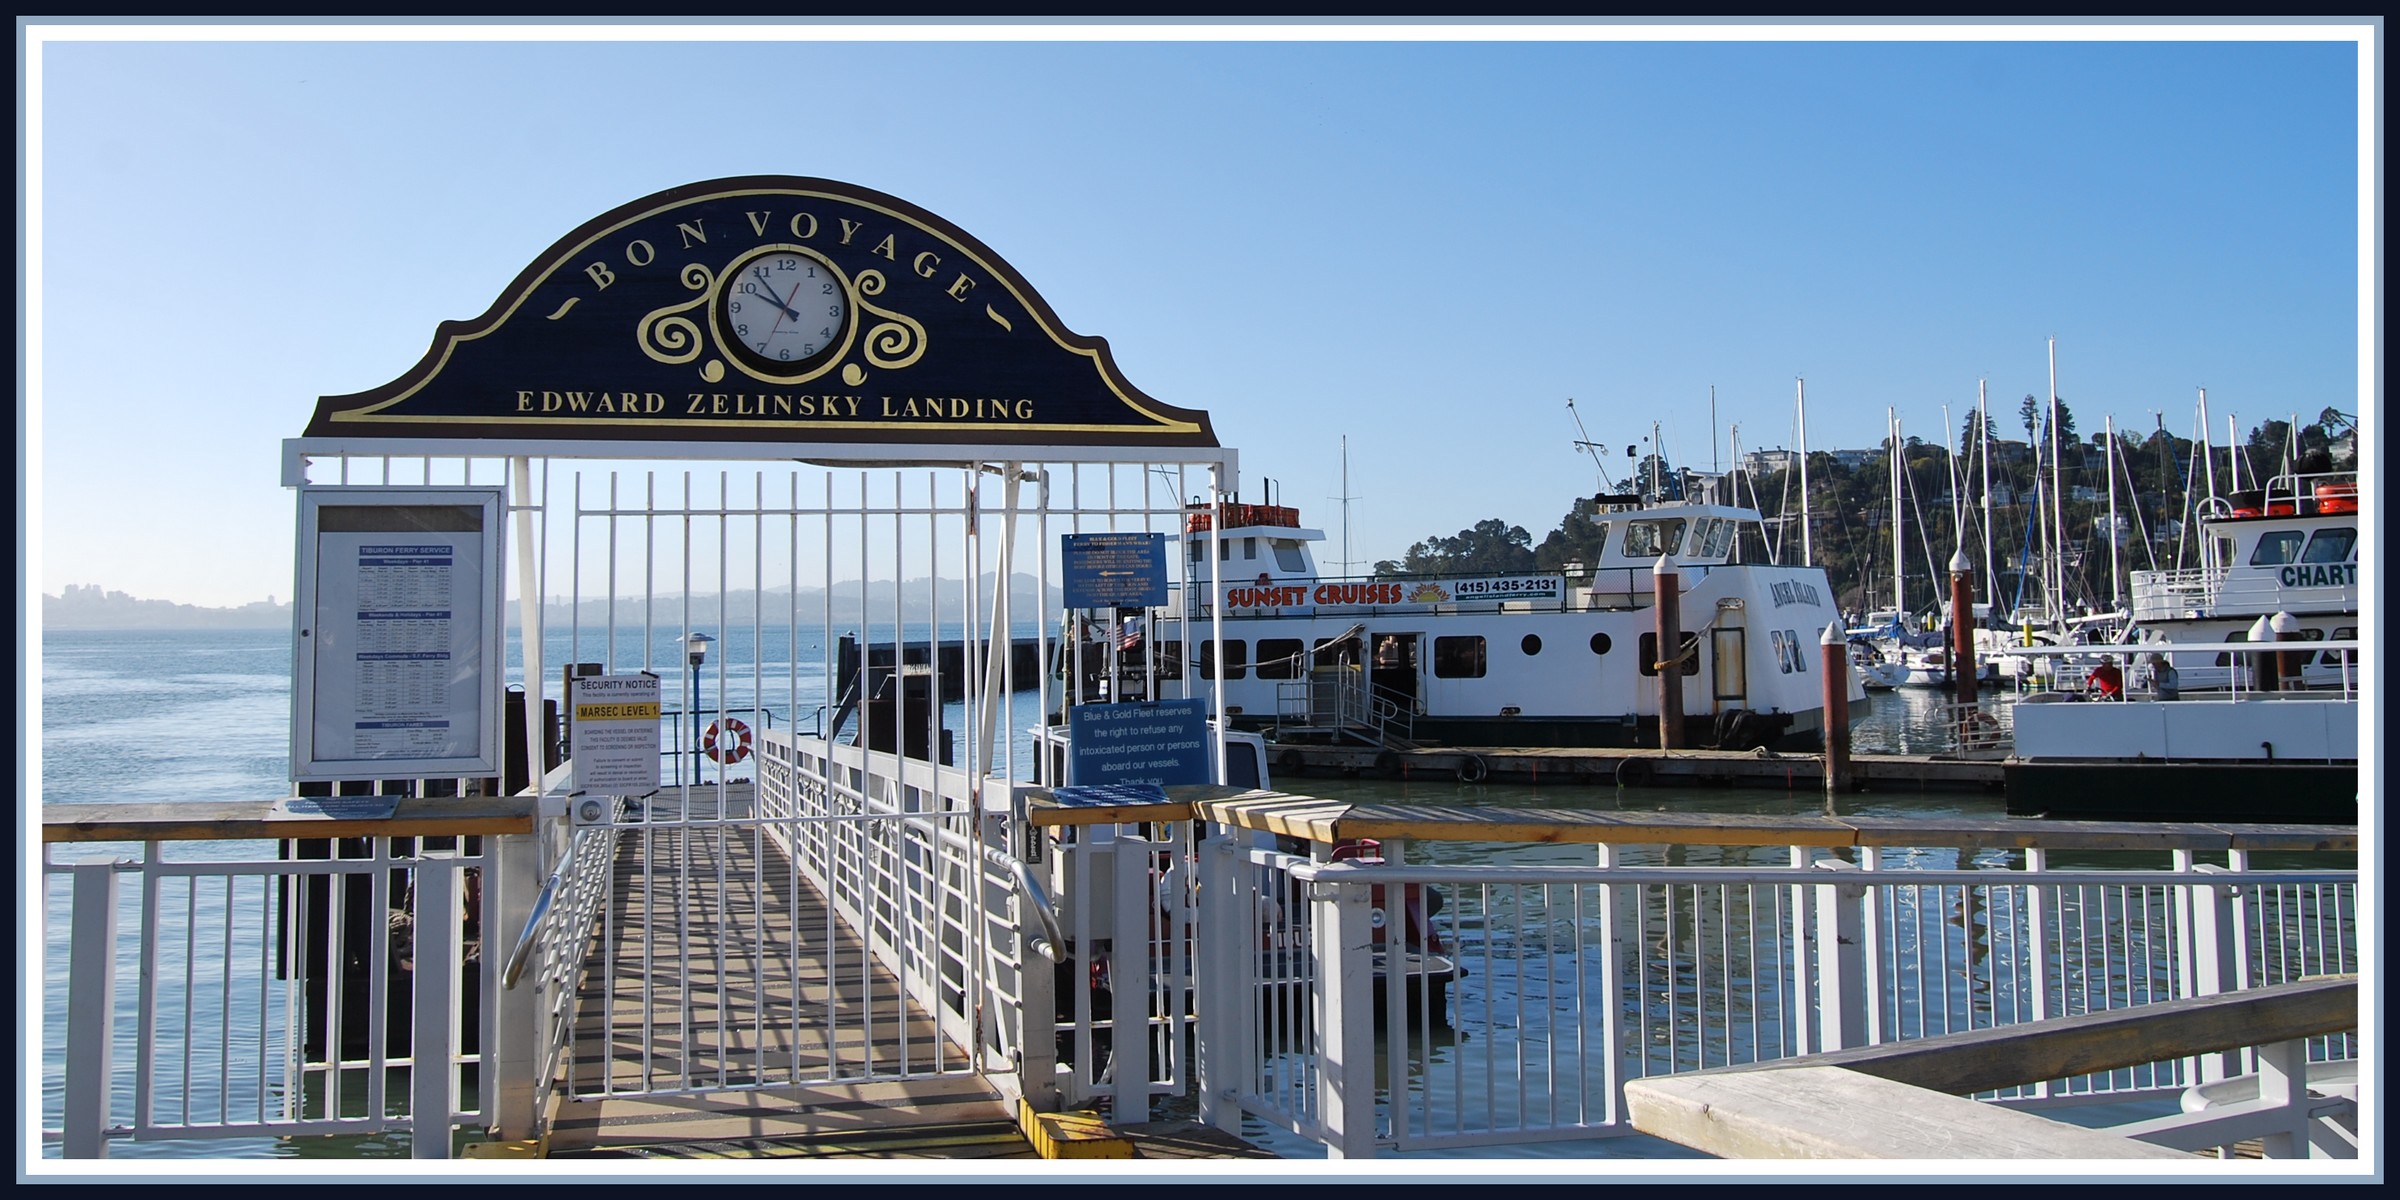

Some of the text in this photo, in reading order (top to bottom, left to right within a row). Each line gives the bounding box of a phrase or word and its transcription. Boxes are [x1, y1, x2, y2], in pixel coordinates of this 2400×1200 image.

[584, 211, 977, 303] BON VOYAGE
[777, 259, 797, 271] 12
[753, 266, 771, 278] 11
[807, 267, 816, 278] 1
[737, 282, 756, 294] 10
[822, 283, 833, 295] 2
[730, 302, 741, 313] 9
[829, 305, 839, 317] 3
[737, 324, 749, 336] 8
[820, 327, 831, 339] 4
[757, 342, 767, 354] 7
[804, 344, 814, 356] 5
[779, 349, 790, 360] 6
[516, 390, 1034, 419] EDWARD ZELINSKY LANDING
[2281, 564, 2357, 587] CHART
[1454, 579, 1557, 594] (415) 435-2131
[1227, 584, 1402, 608] SUNSET CRUISES
[1770, 581, 1796, 609] ANGEL
[580, 680, 657, 690] SECURITY NOTICE
[580, 705, 657, 717] MARSEC LEVEL 1
[1083, 707, 1192, 721] Blue & Gold Fleet reserves
[1094, 724, 1184, 738] the right to refuse any
[1079, 740, 1200, 756] intoxicated person or persons
[1102, 758, 1180, 772] aboard our vessels.
[1119, 777, 1146, 785] Thank
